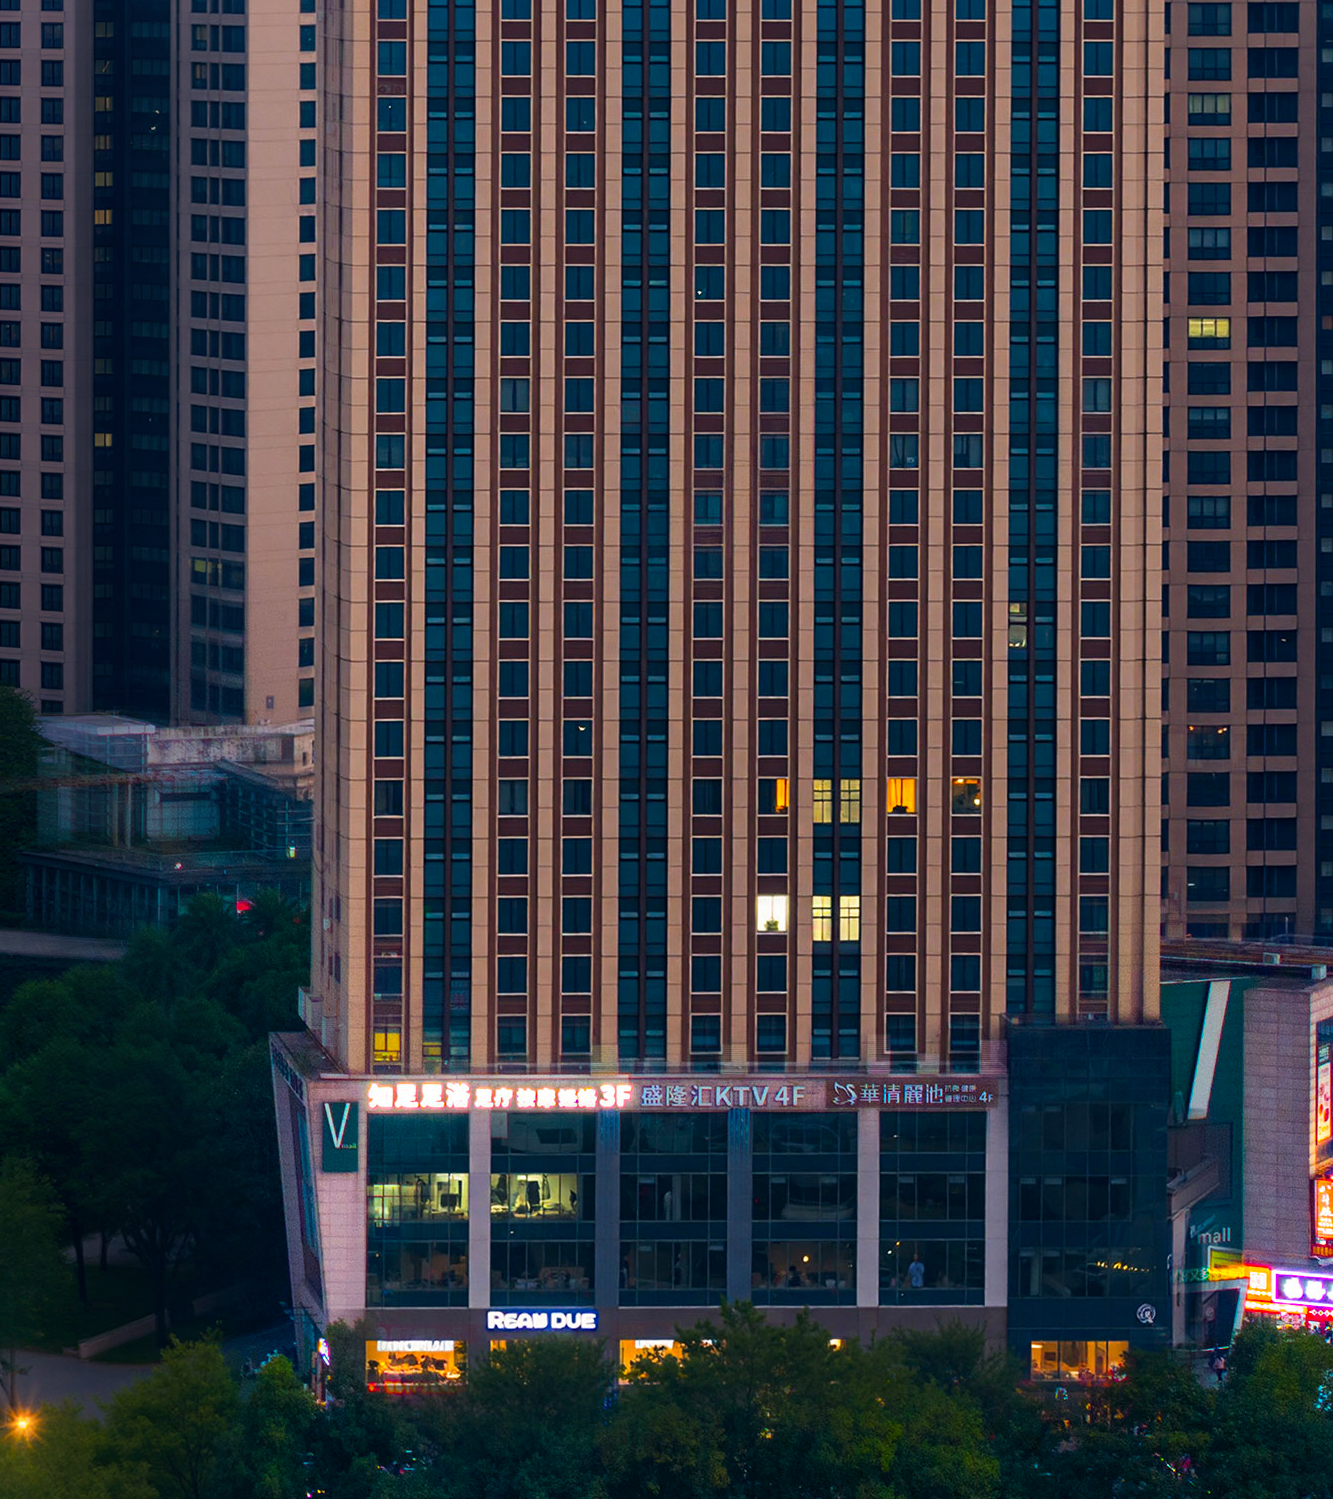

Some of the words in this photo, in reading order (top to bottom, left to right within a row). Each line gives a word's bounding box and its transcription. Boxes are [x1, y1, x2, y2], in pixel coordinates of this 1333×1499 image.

[599, 1084, 632, 1108] 3F
[774, 1085, 806, 1107] 4F
[551, 1312, 597, 1329] DUE
